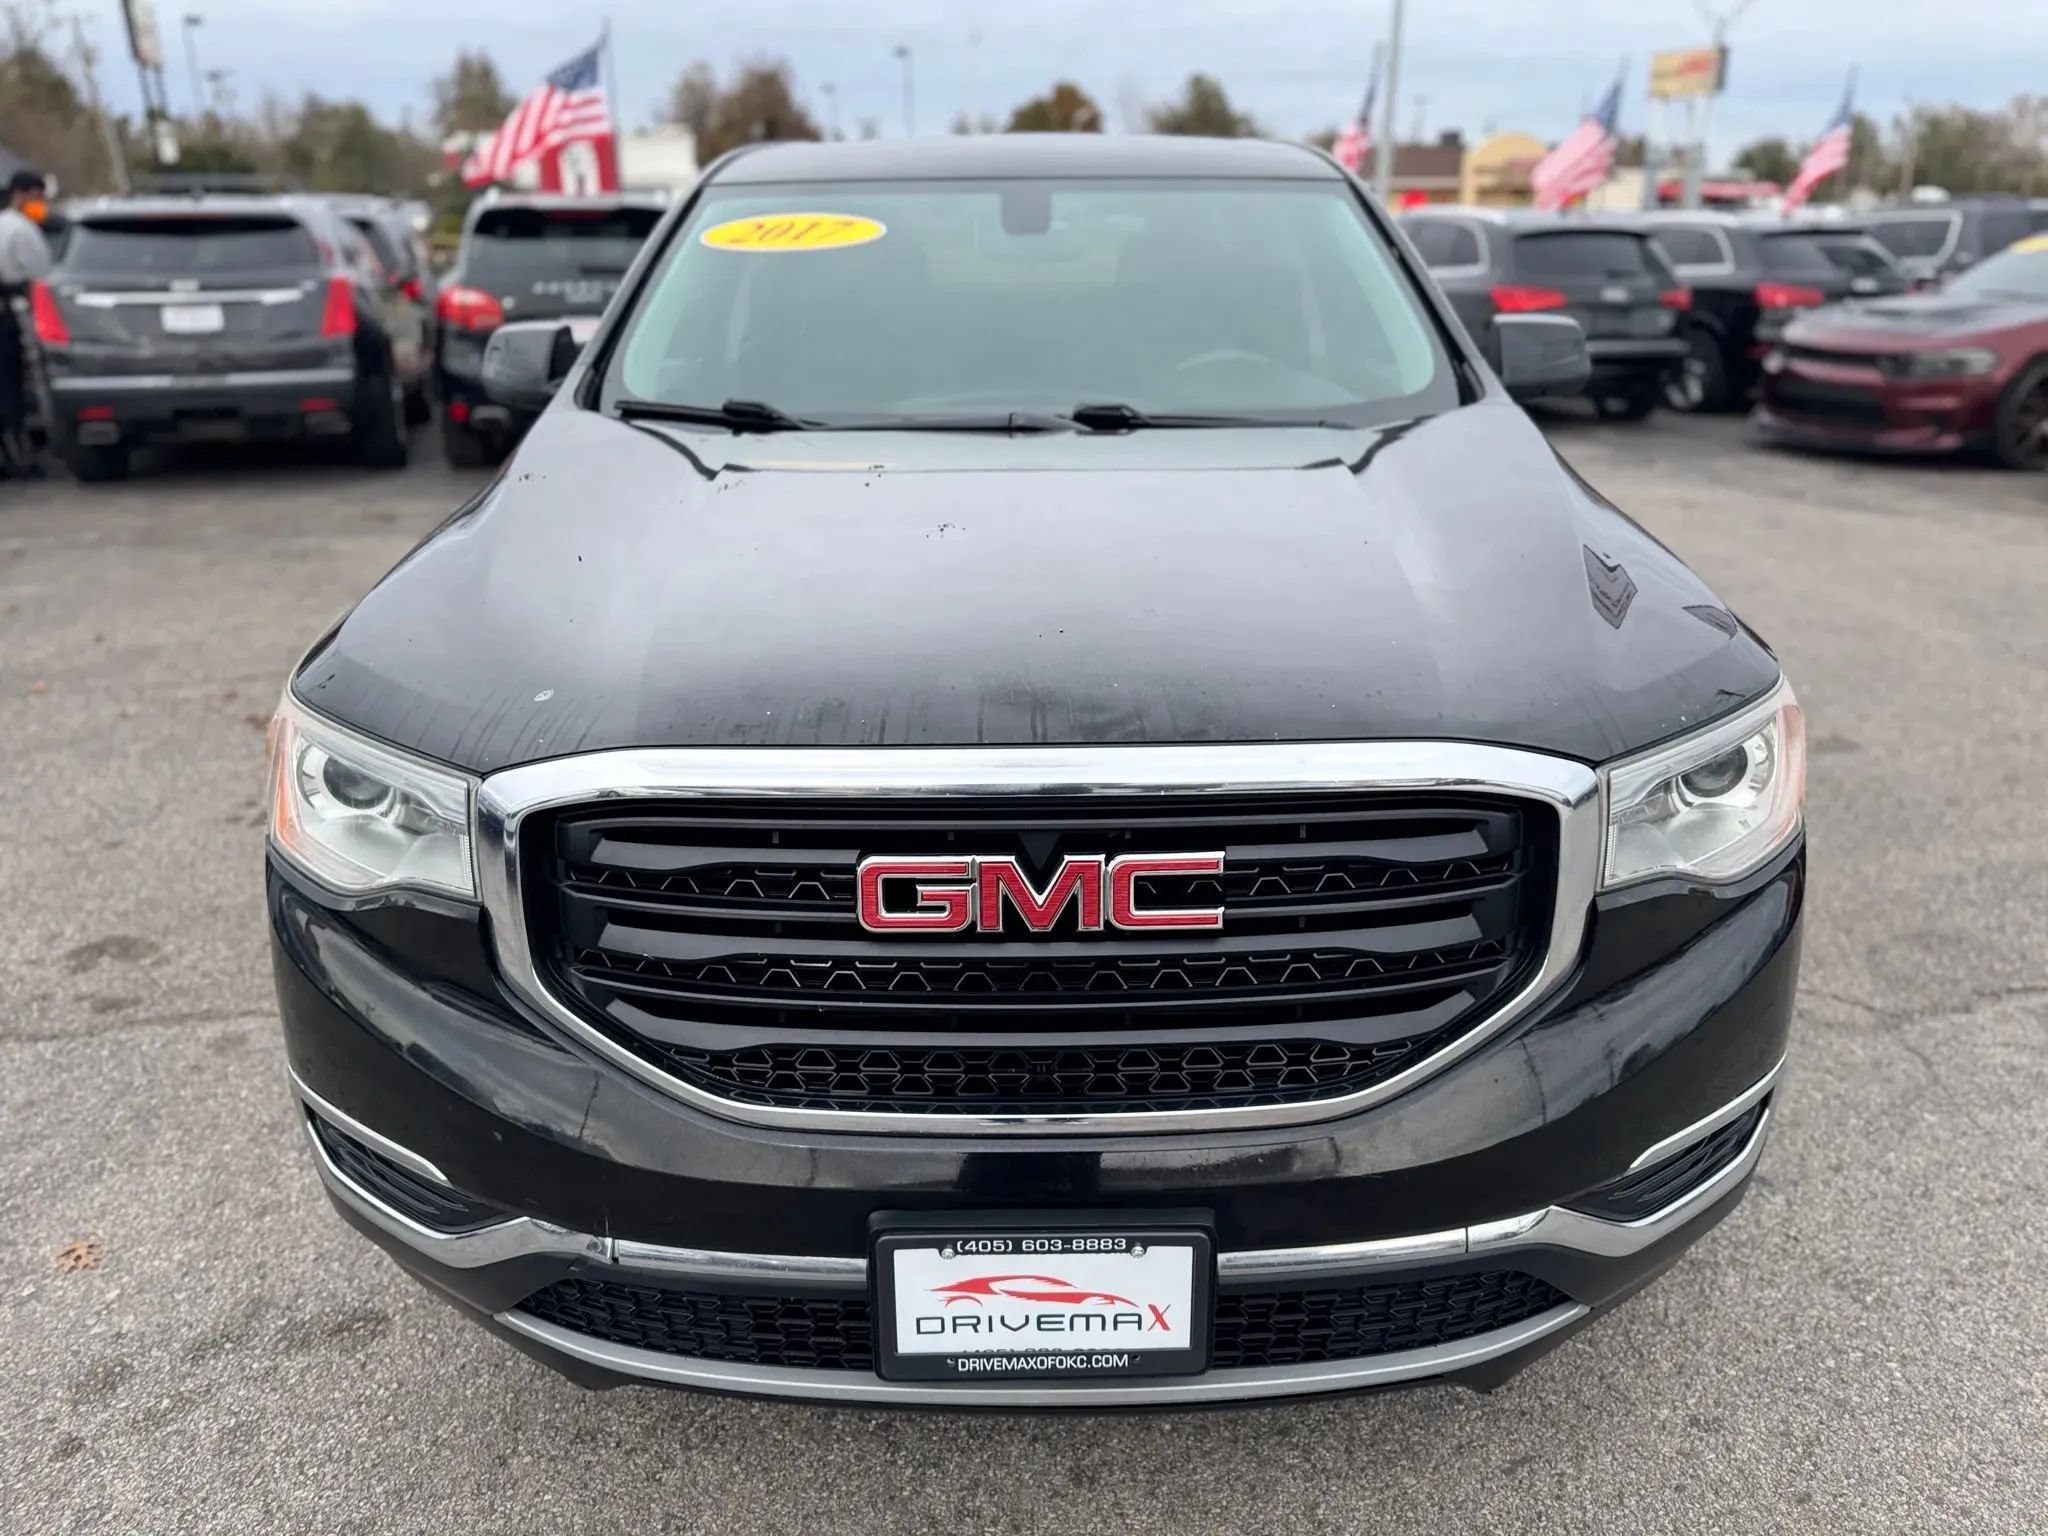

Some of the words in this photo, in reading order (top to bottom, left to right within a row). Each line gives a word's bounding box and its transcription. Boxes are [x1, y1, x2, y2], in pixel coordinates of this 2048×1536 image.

[727, 222, 857, 244] 2017
[857, 851, 1226, 932] GMC
[956, 1239, 1013, 1253] (405)
[1022, 1237, 1127, 1251] 603-8883
[916, 1303, 1172, 1335] DRIVEMAX
[957, 1354, 1129, 1372] DRIVEMAXOFOKC.COM
